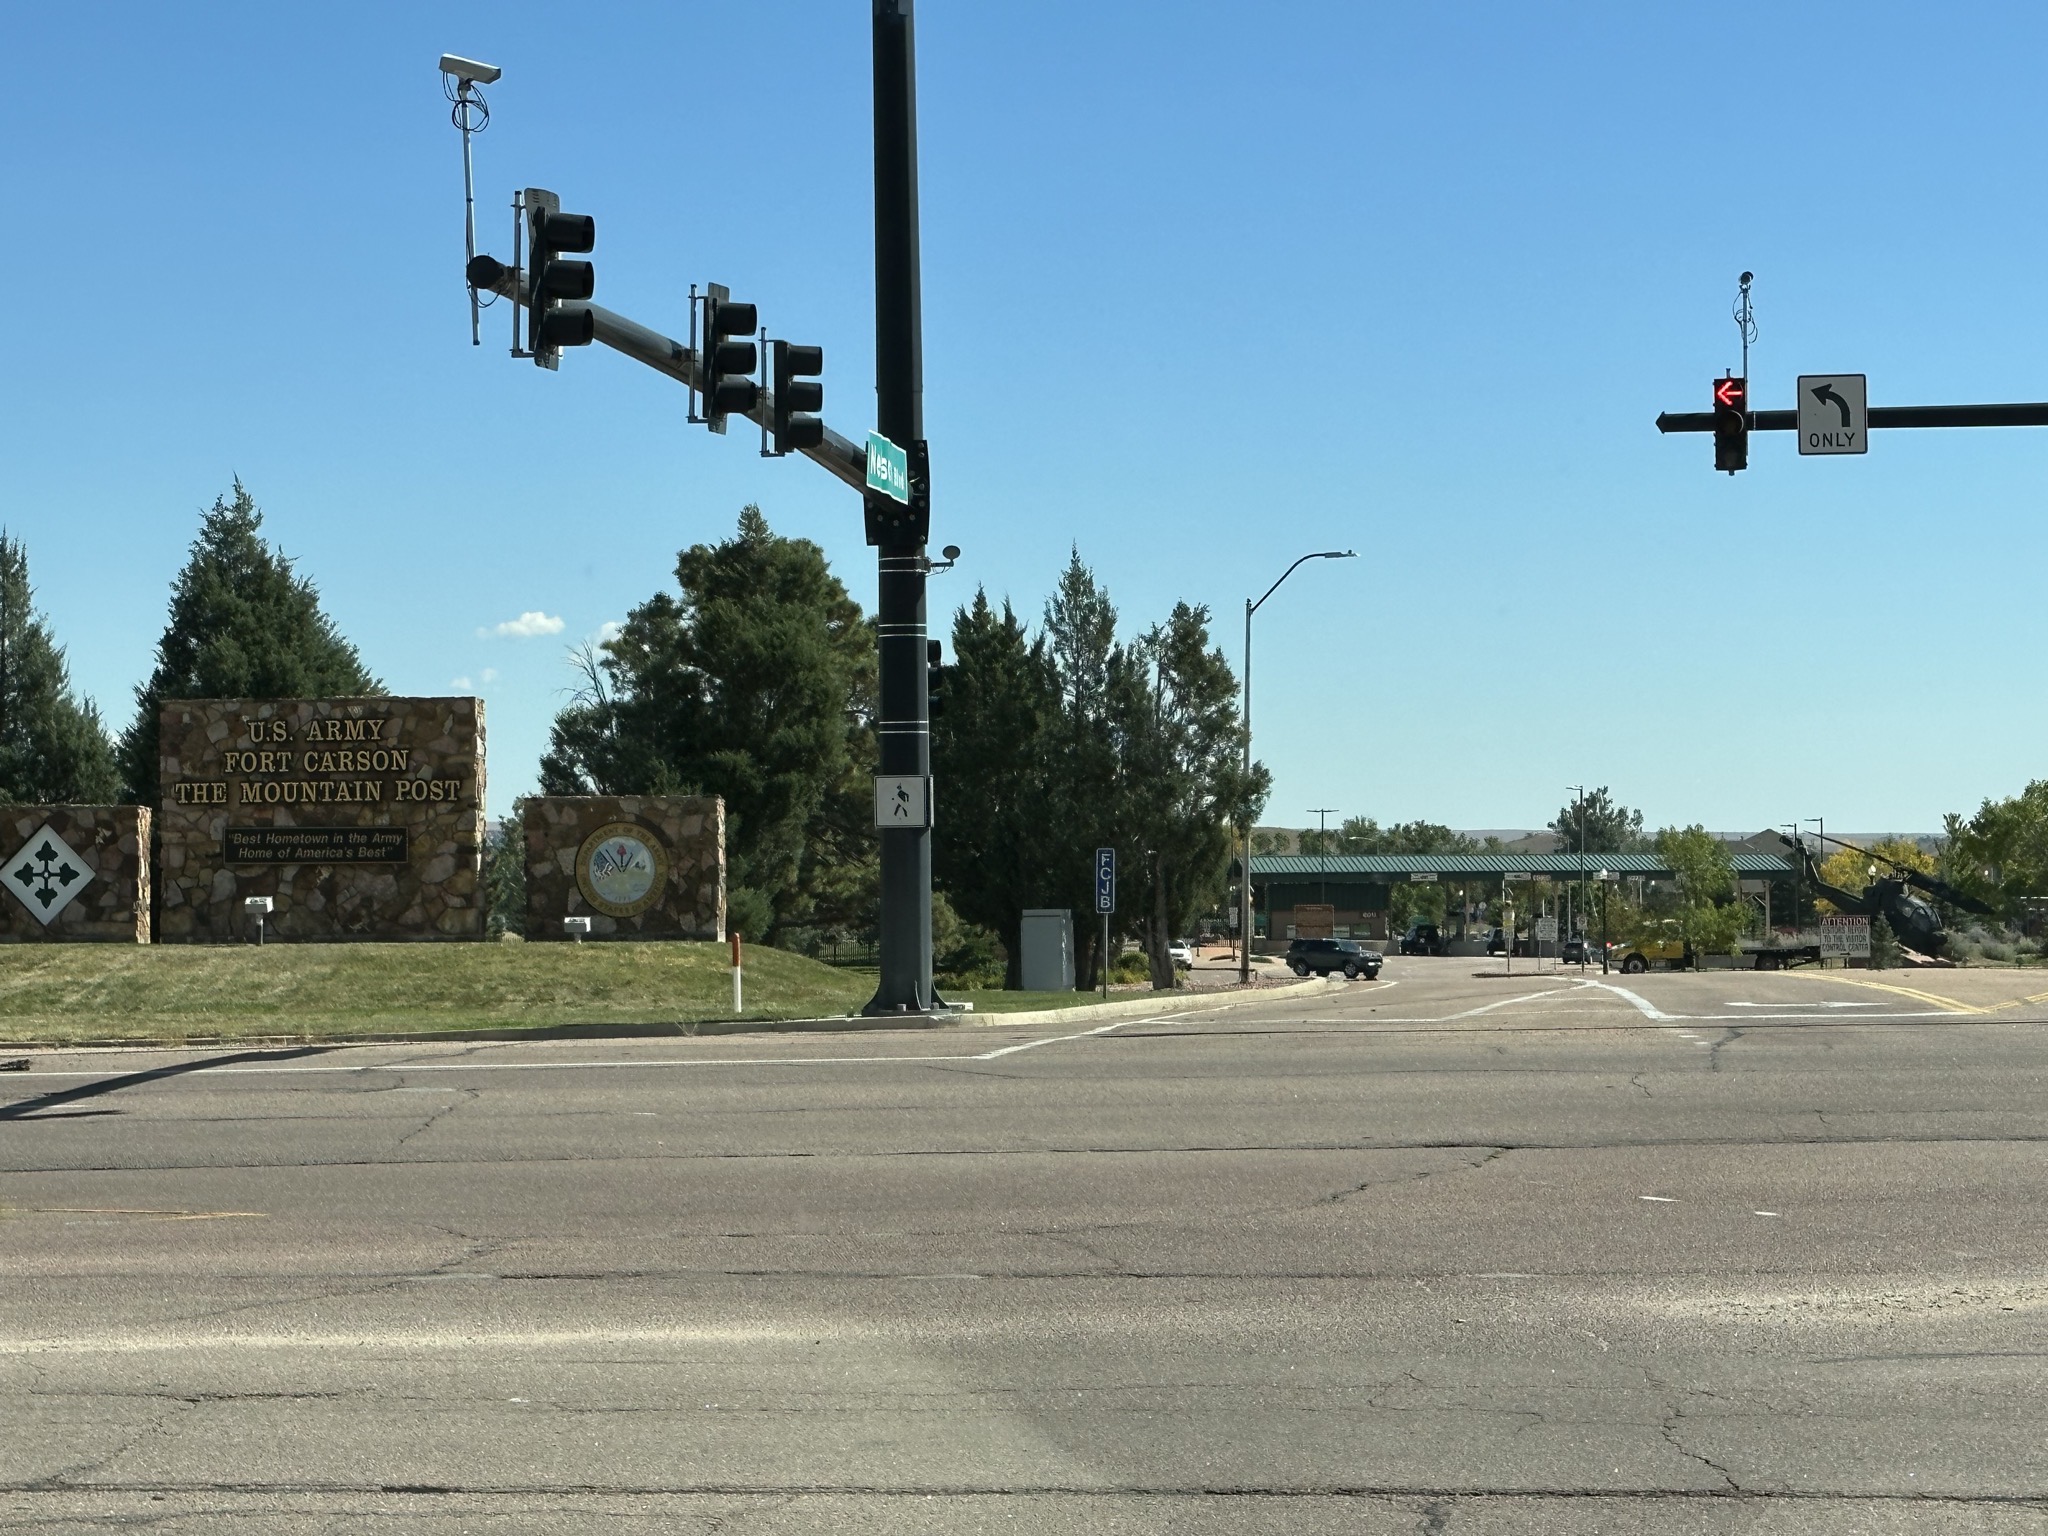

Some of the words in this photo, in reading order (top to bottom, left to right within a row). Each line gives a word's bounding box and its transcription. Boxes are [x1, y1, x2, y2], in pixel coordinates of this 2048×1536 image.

[1809, 432, 1856, 448] ONLY
[248, 720, 294, 742] U.S.
[306, 719, 385, 741] ARMY
[224, 751, 292, 773] FORT
[303, 750, 409, 773] CARSON
[175, 782, 227, 804] THE
[240, 781, 382, 803] MOUNTAIN
[395, 780, 460, 801] POST
[266, 833, 328, 844] Hometown
[333, 833, 343, 843] in
[349, 833, 369, 843] the
[372, 832, 403, 845] Army
[239, 847, 273, 858] Home
[277, 846, 291, 858] of
[294, 847, 354, 858] America's
[1821, 917, 1869, 926] ATTENTION
